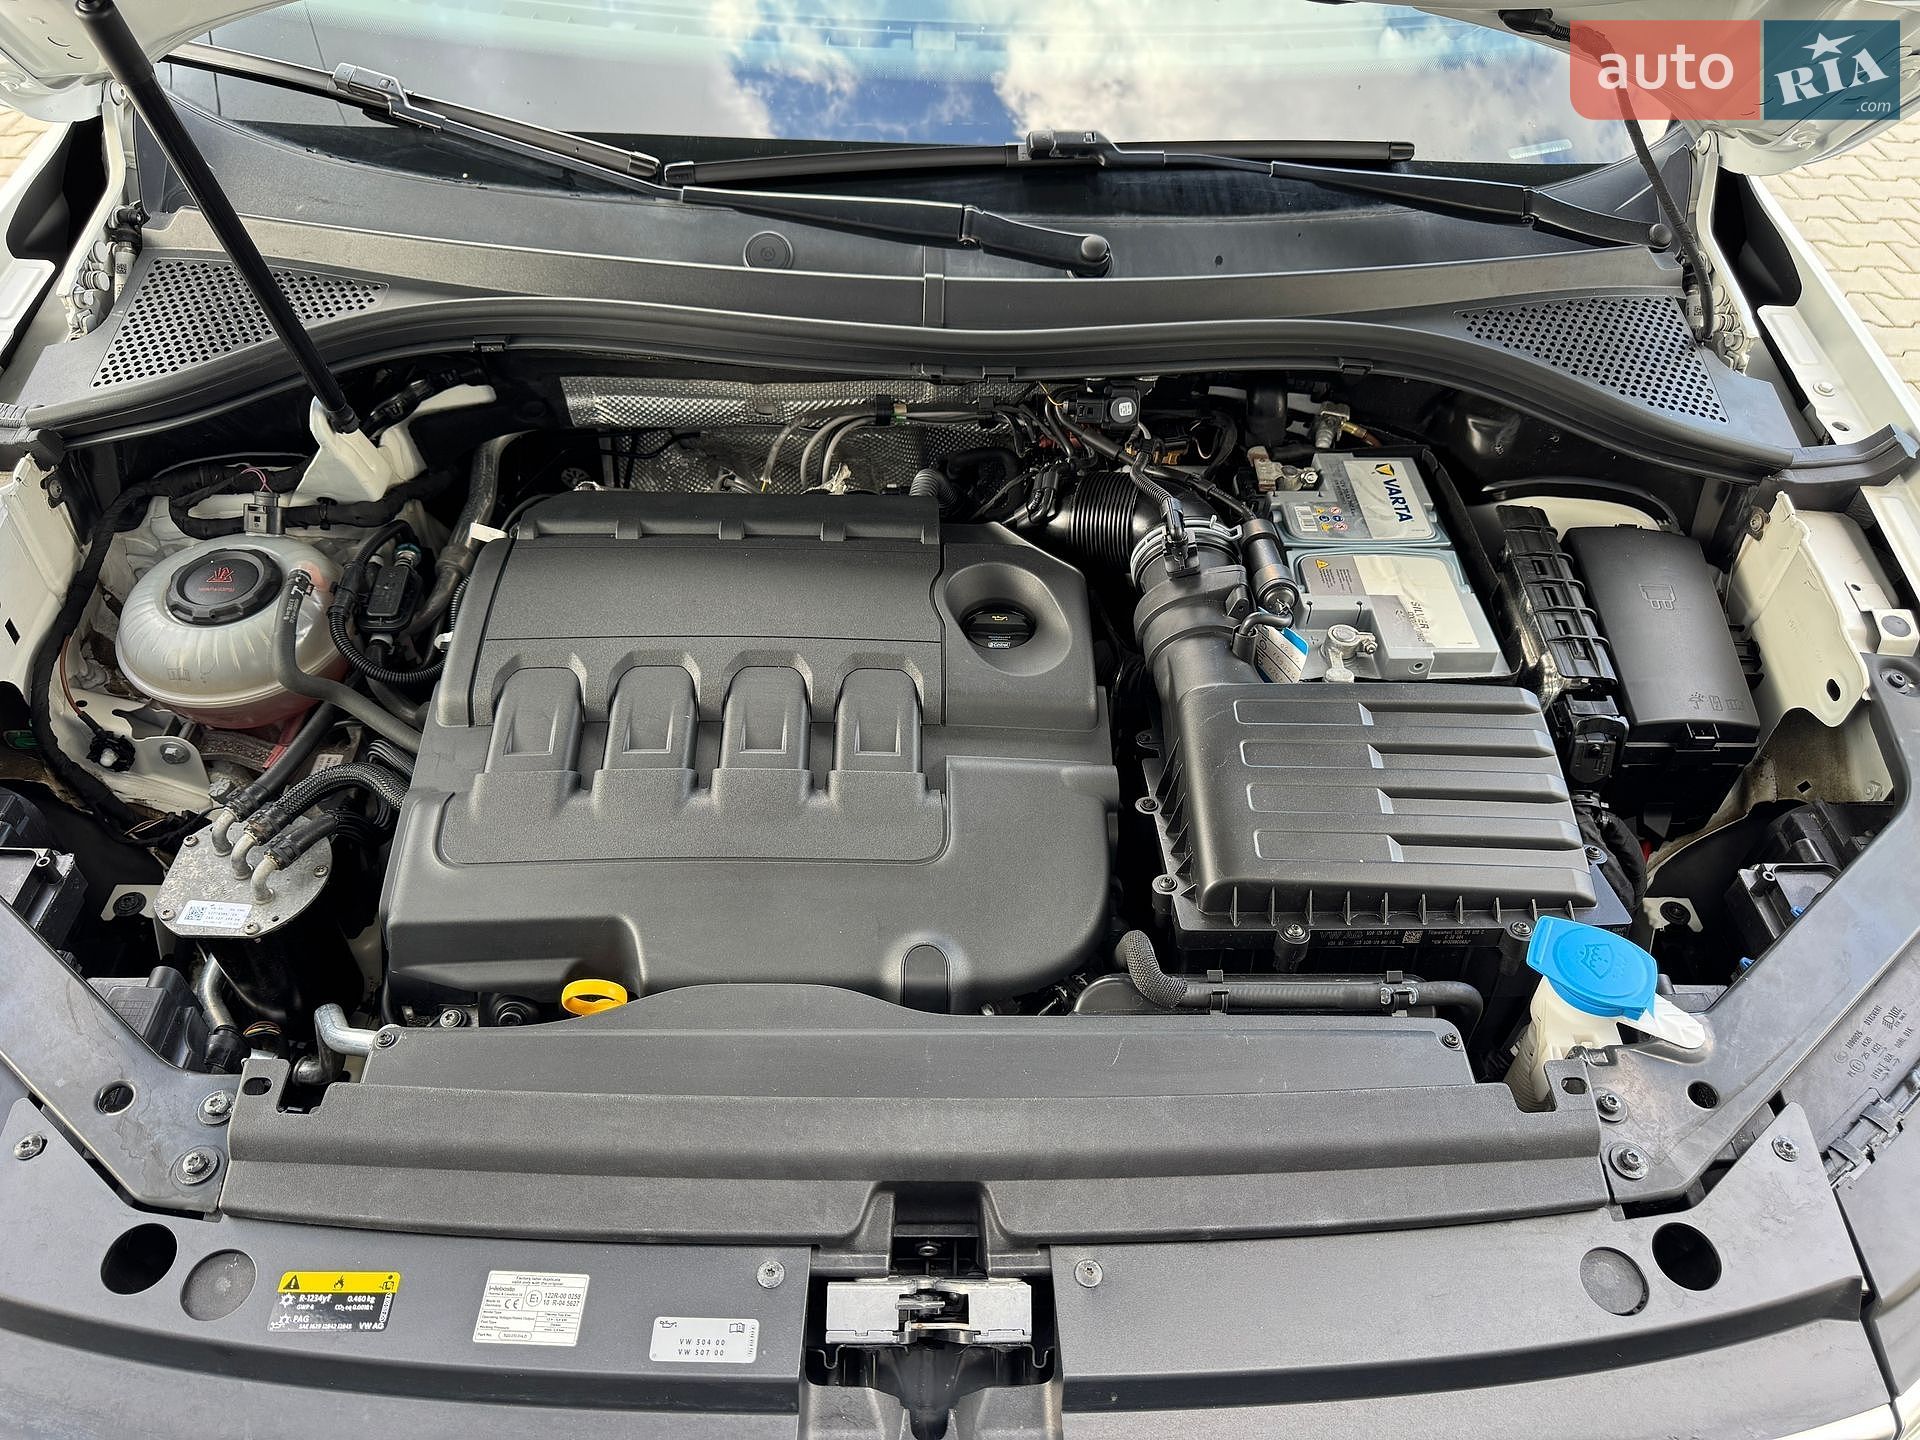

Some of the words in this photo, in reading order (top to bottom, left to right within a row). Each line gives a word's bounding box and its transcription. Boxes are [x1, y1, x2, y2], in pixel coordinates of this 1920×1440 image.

[1383, 478, 1414, 523] VARTA
[1410, 601, 1430, 631] SILVER
[298, 1293, 332, 1304] R-1234yf
[366, 1295, 376, 1304] kg
[292, 1315, 310, 1323] PAG
[359, 1322, 373, 1330] VW
[374, 1322, 385, 1330] AG
[696, 1338, 711, 1346] 504
